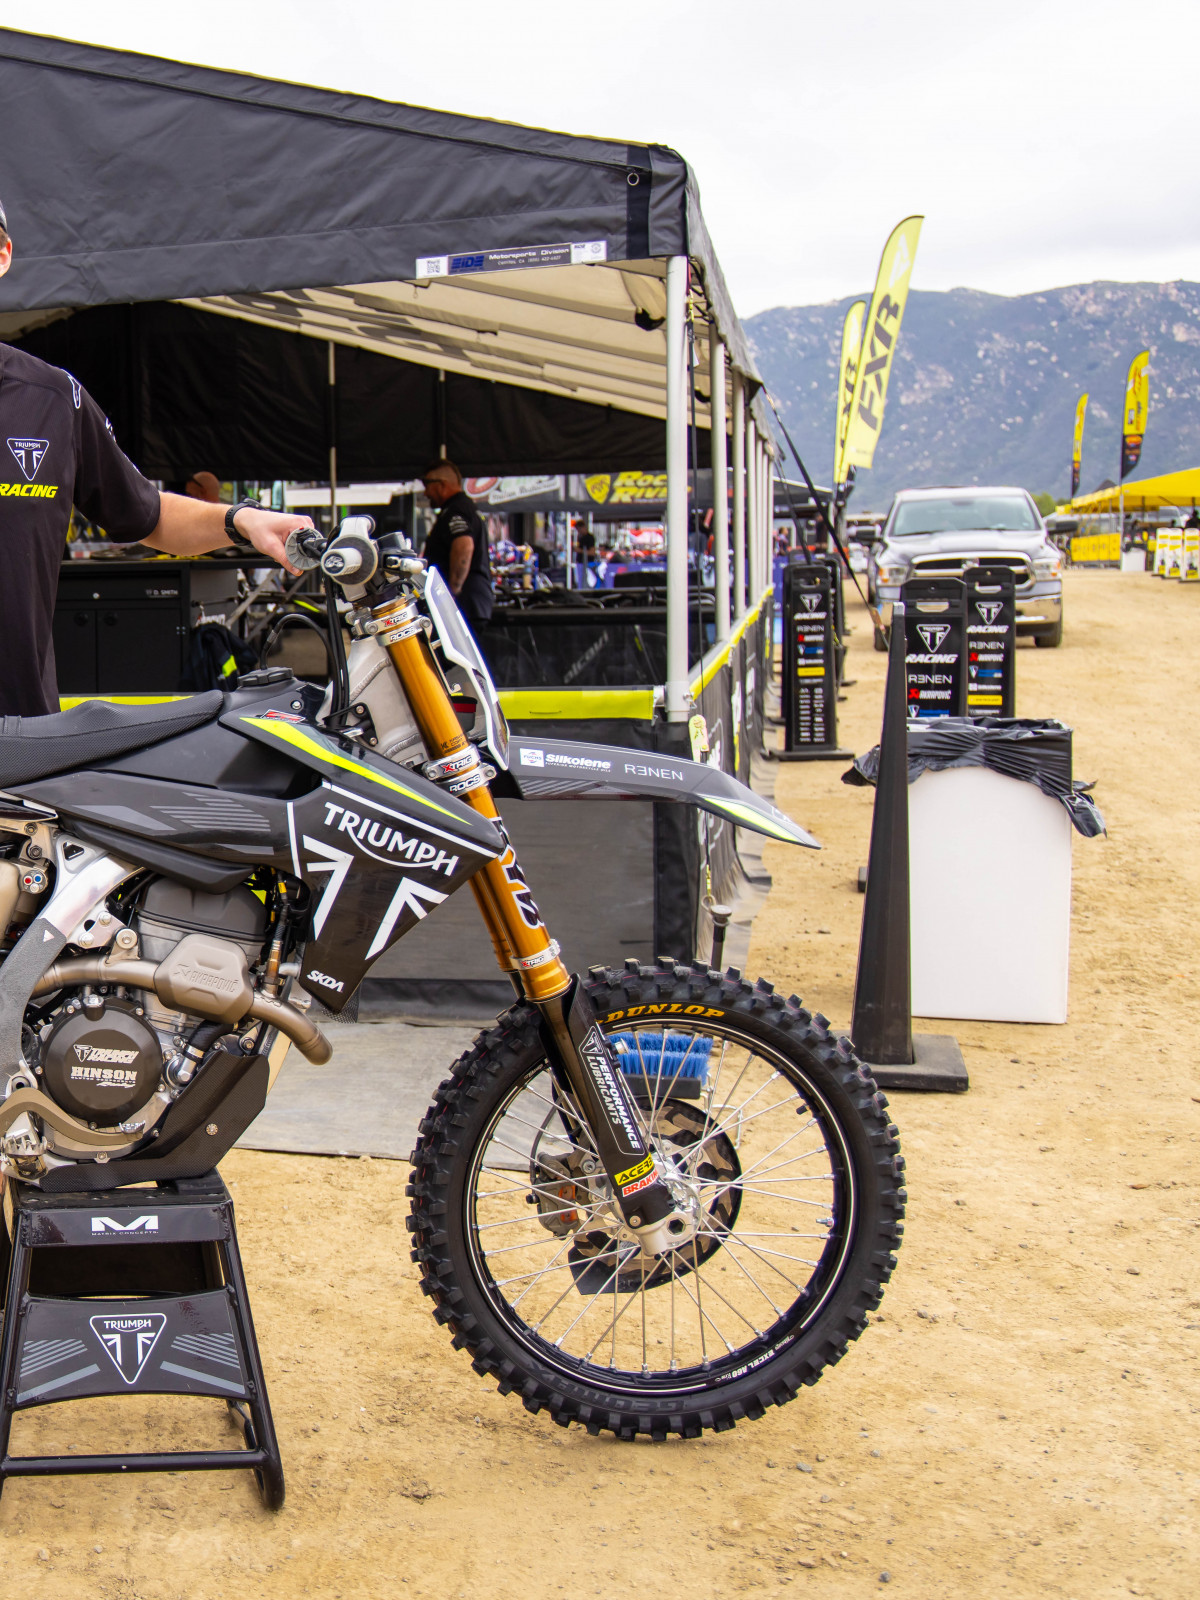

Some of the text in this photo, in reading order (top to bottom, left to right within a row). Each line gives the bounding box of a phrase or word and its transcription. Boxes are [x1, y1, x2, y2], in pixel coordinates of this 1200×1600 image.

[489, 247, 570, 261] Motorsports Division
[14, 441, 41, 450] TRIUMPH
[966, 625, 1009, 633] RACING
[905, 654, 958, 664] RACING
[440, 754, 472, 774] XTRIG
[545, 753, 612, 769] Silkolene
[449, 773, 480, 793] ROCS
[324, 801, 460, 877] TRIUMPH
[306, 969, 345, 993] SKDA
[606, 1003, 725, 1024] DUNLOP
[71, 1066, 138, 1081] HINSON
[586, 1055, 621, 1125] LUBRICANTS
[596, 1056, 640, 1149] PERFORMANCE
[623, 1169, 658, 1196] BRAKIN
[103, 1319, 152, 1331] TRIUMPH
[746, 1349, 774, 1369] EXCEL
